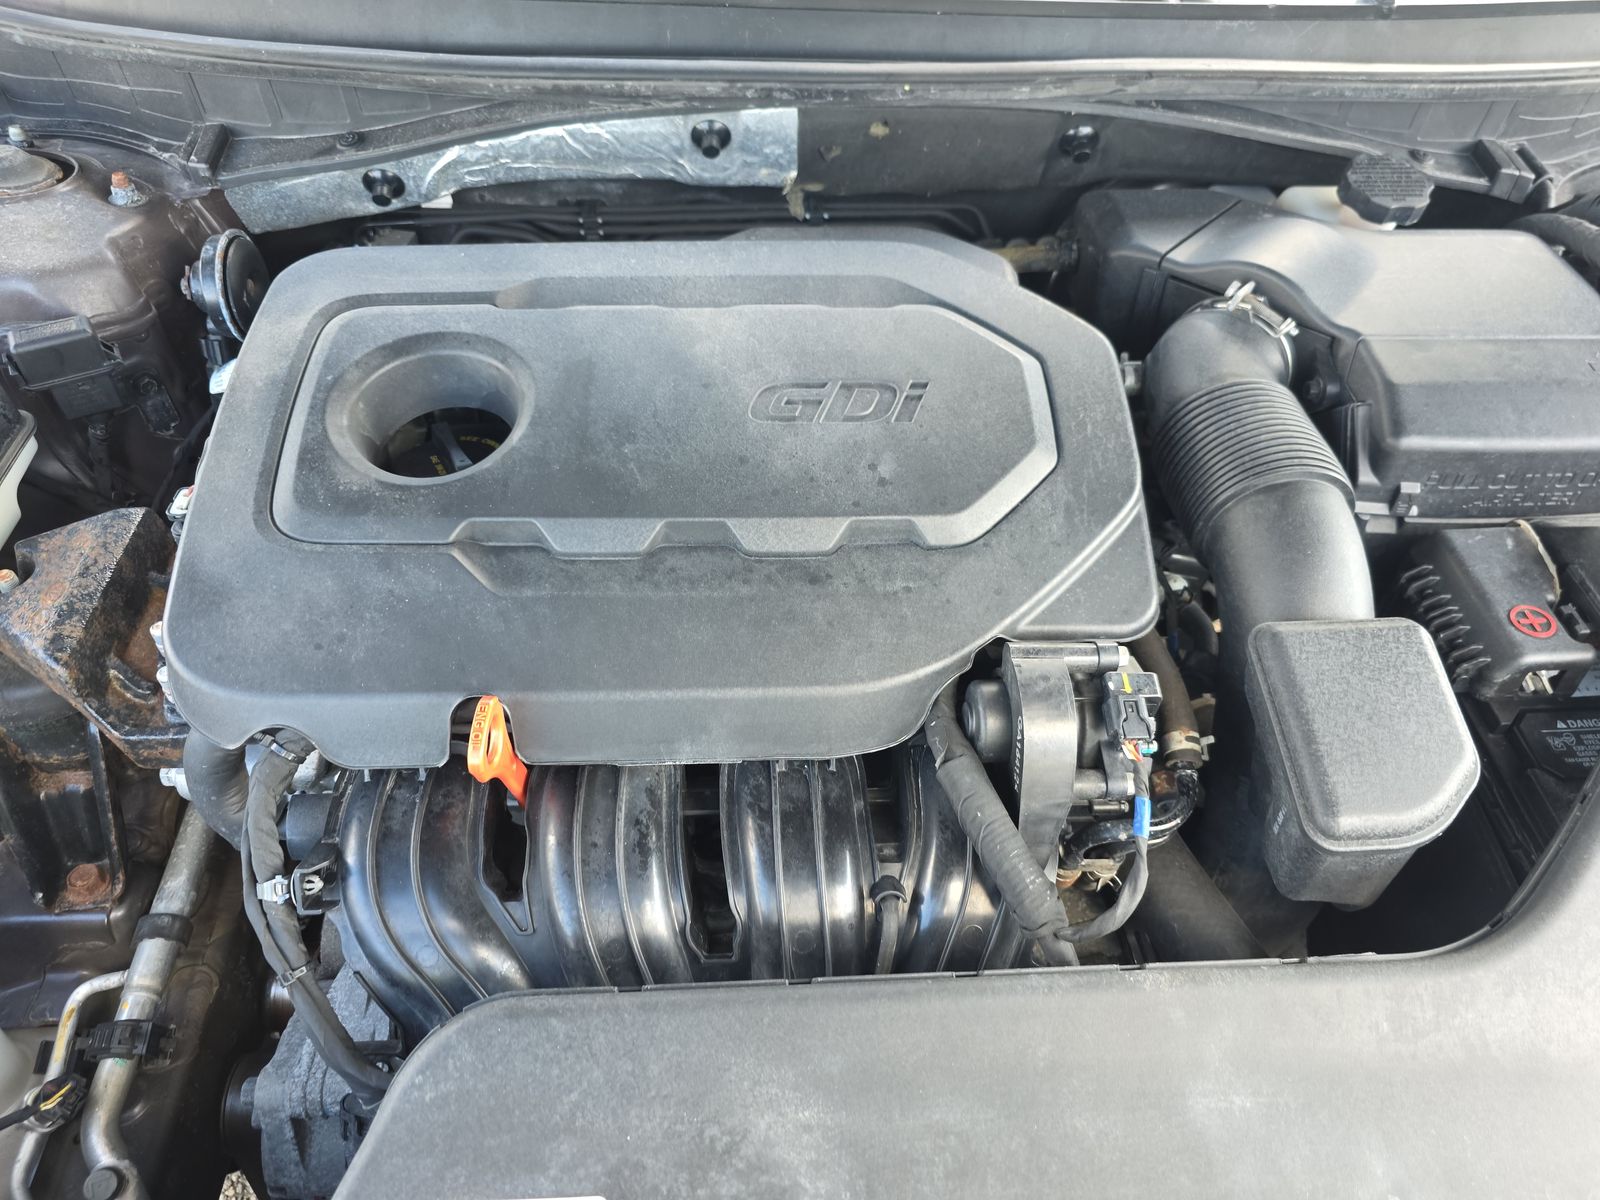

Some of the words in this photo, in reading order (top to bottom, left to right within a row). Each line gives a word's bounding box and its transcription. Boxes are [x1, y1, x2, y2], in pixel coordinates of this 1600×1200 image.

[748, 380, 930, 424] GDi
[474, 703, 488, 729] ENG
[471, 731, 482, 751] OIL
